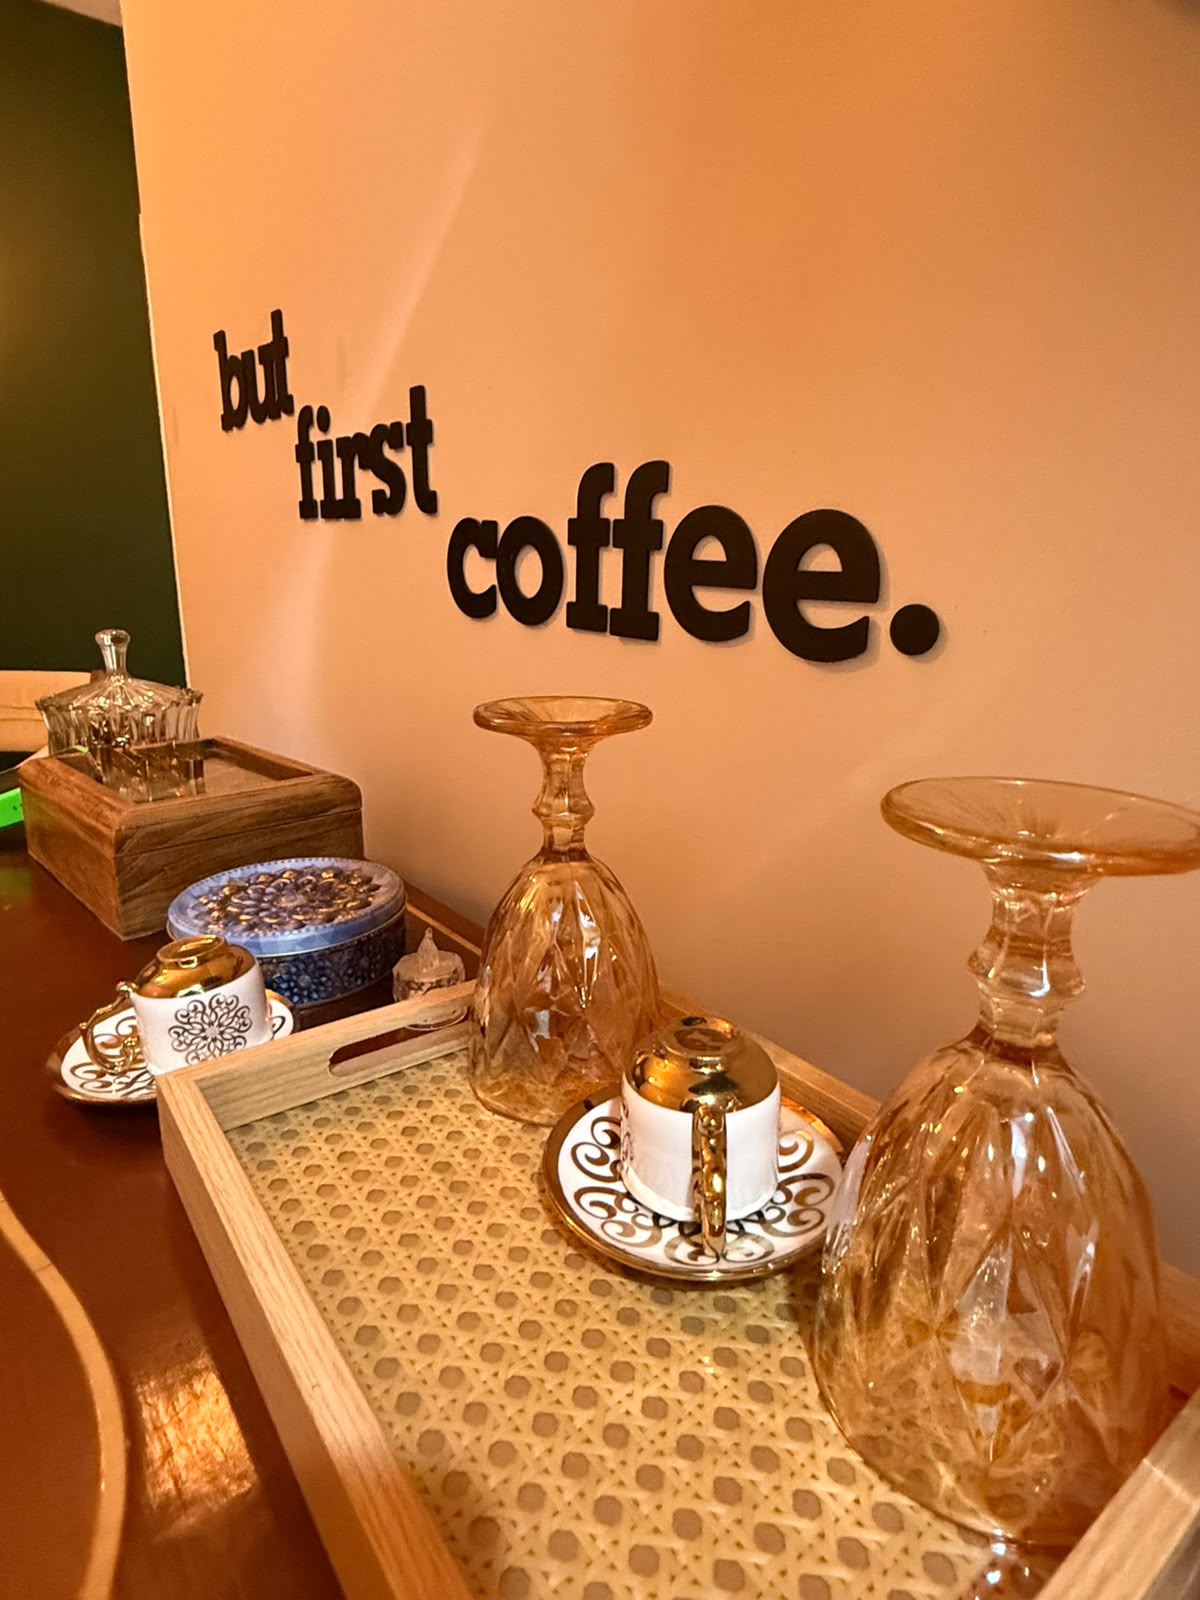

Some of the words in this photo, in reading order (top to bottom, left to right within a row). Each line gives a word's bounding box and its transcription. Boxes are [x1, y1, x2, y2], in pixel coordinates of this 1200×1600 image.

[213, 309, 294, 432] but
[295, 385, 438, 521] first
[447, 460, 940, 664] coffee.
